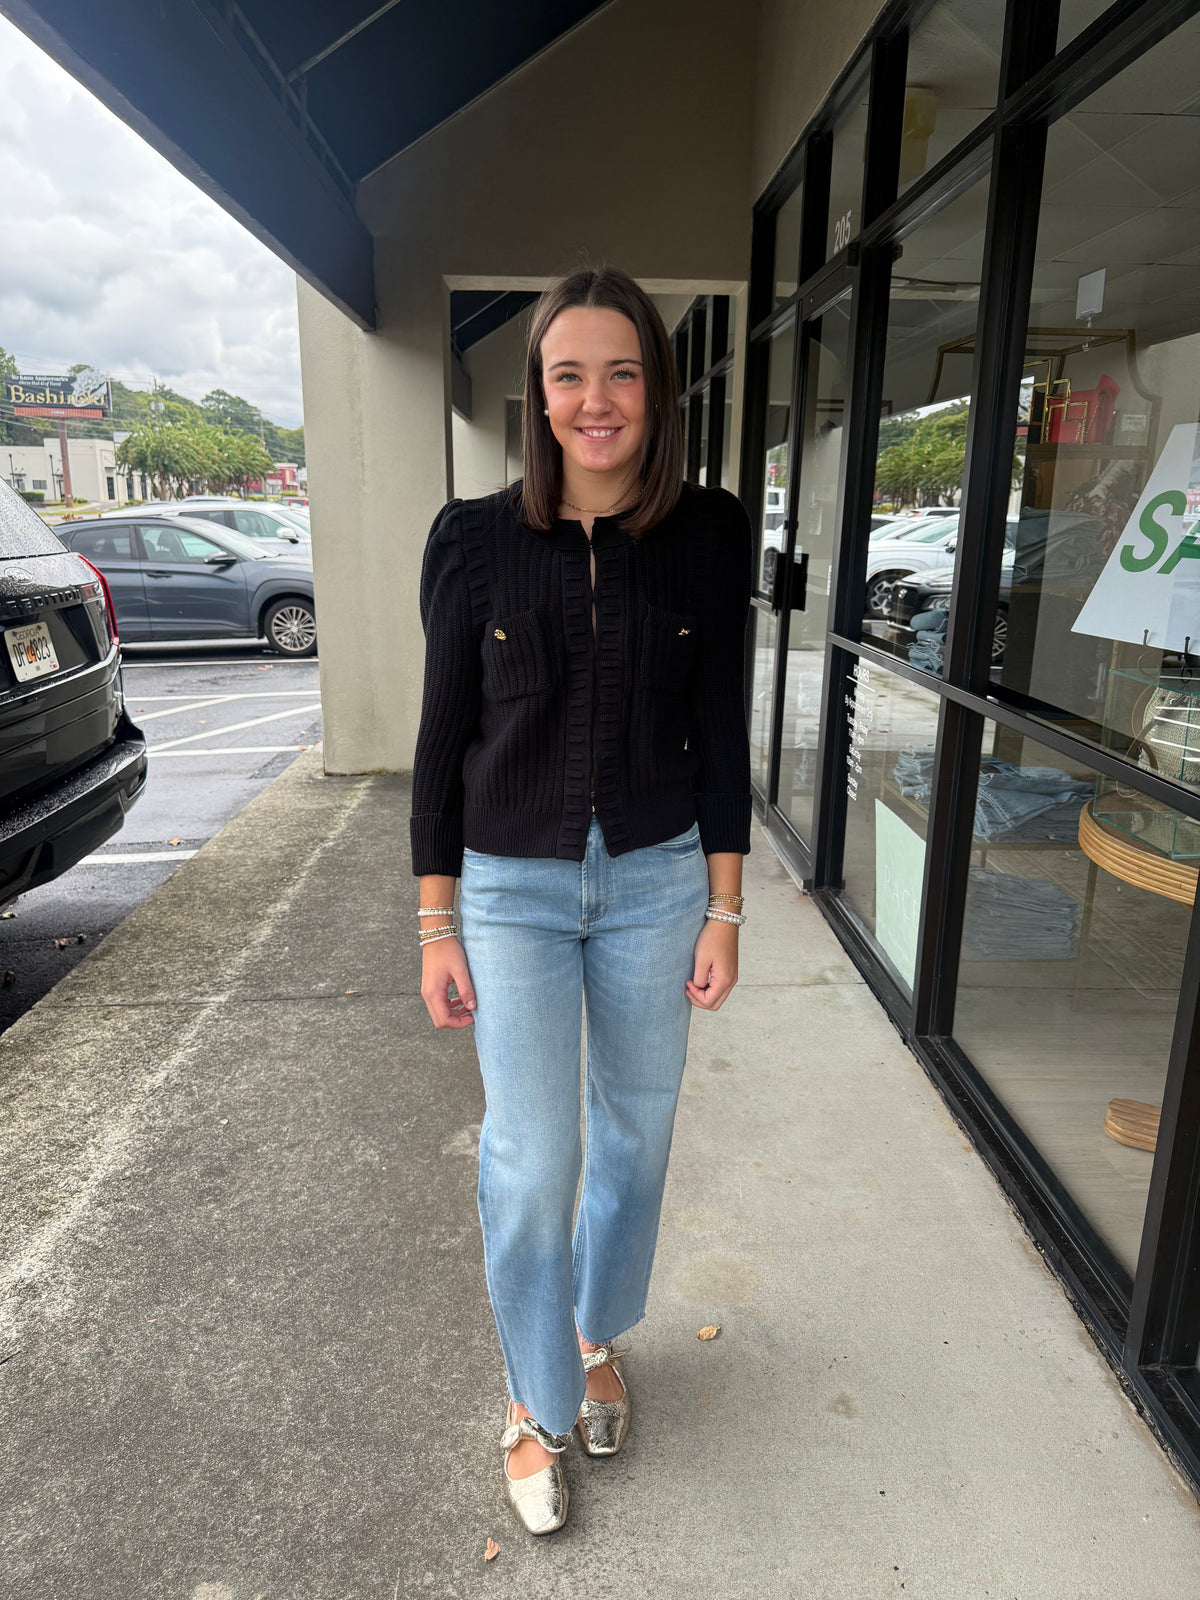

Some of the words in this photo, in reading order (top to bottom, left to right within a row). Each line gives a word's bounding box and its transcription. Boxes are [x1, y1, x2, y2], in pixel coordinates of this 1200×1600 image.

[834, 209, 851, 256] 205
[8, 384, 105, 406] Bashinski
[853, 664, 870, 683] HOURS
